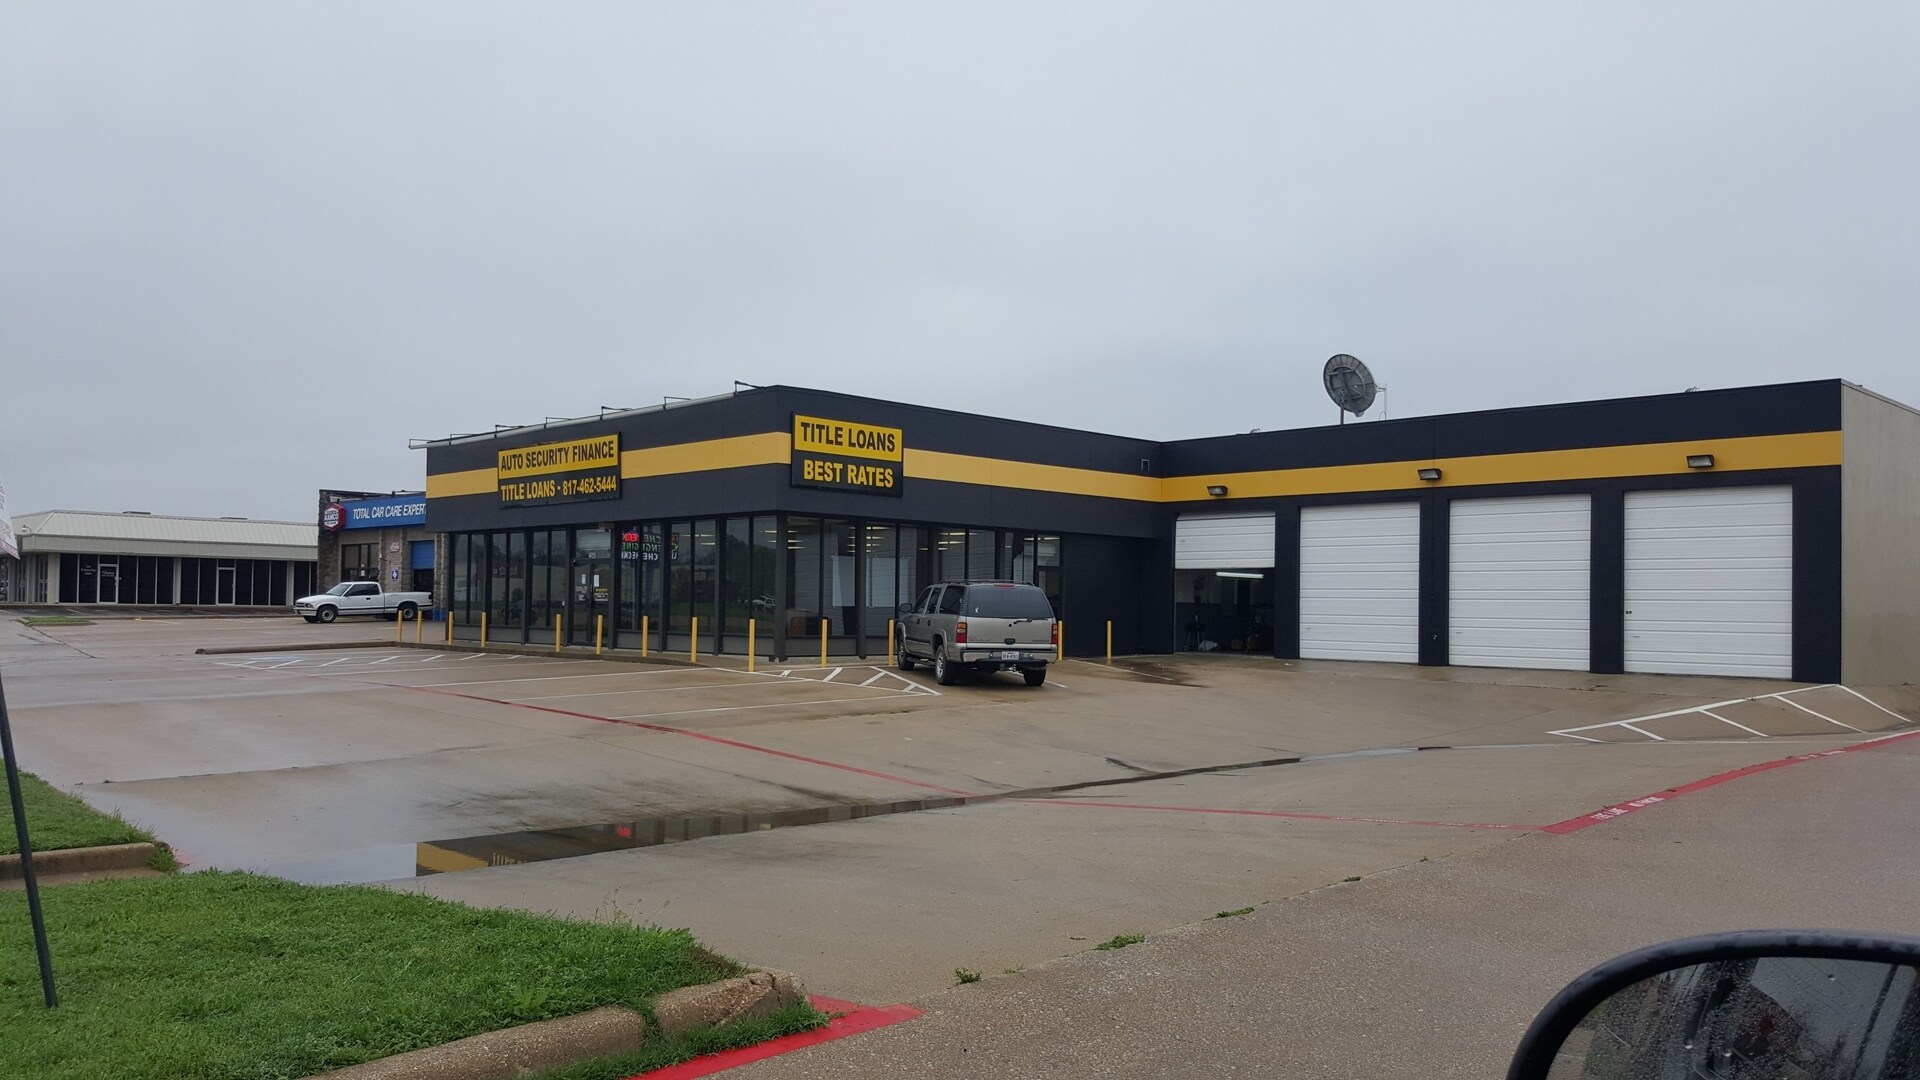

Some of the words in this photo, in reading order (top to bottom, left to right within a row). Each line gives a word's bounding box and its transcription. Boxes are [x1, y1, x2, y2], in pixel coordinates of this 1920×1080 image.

[800, 421, 844, 447] TITLE
[848, 428, 895, 452] LOANS
[500, 452, 523, 472] AUTO
[525, 446, 570, 468] SECURITY
[572, 440, 614, 463] FINANCE
[803, 459, 843, 483] BEST
[847, 464, 894, 488] RATES
[500, 483, 525, 502] TITLE
[526, 480, 556, 499] LOANS
[562, 475, 617, 496] 817-462-5444
[353, 508, 370, 519] TOTAL
[372, 506, 384, 518] CAR
[385, 506, 402, 517] CARE
